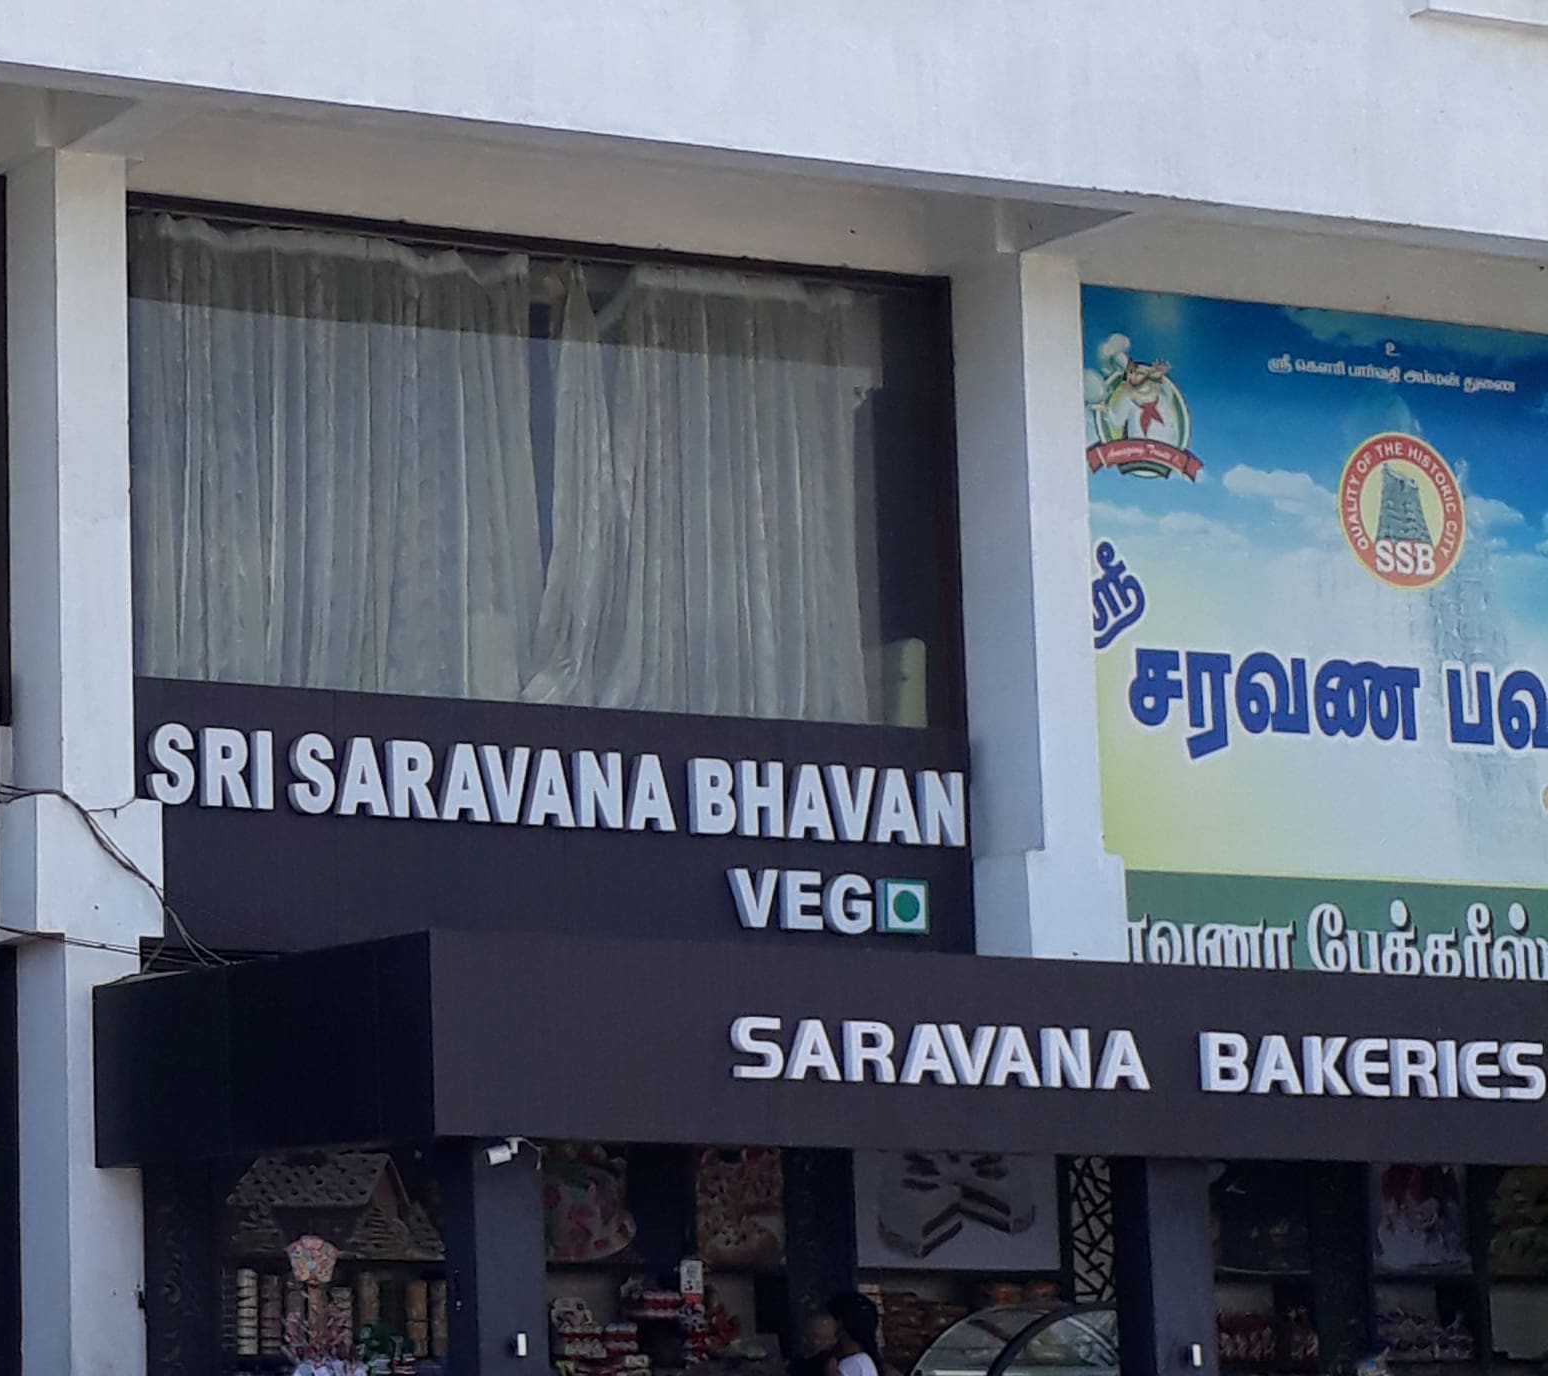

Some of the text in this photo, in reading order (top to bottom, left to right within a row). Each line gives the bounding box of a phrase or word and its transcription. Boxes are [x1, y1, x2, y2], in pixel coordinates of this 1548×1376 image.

[1345, 442, 1458, 559] QUALITY OF THE HISTORIC CITY
[1374, 539, 1437, 575] SSB
[147, 722, 967, 849] SRI SARAVANA BHAVAN
[726, 867, 876, 935] VEG
[730, 1015, 1548, 1103] SARAVANA BAKERIES
